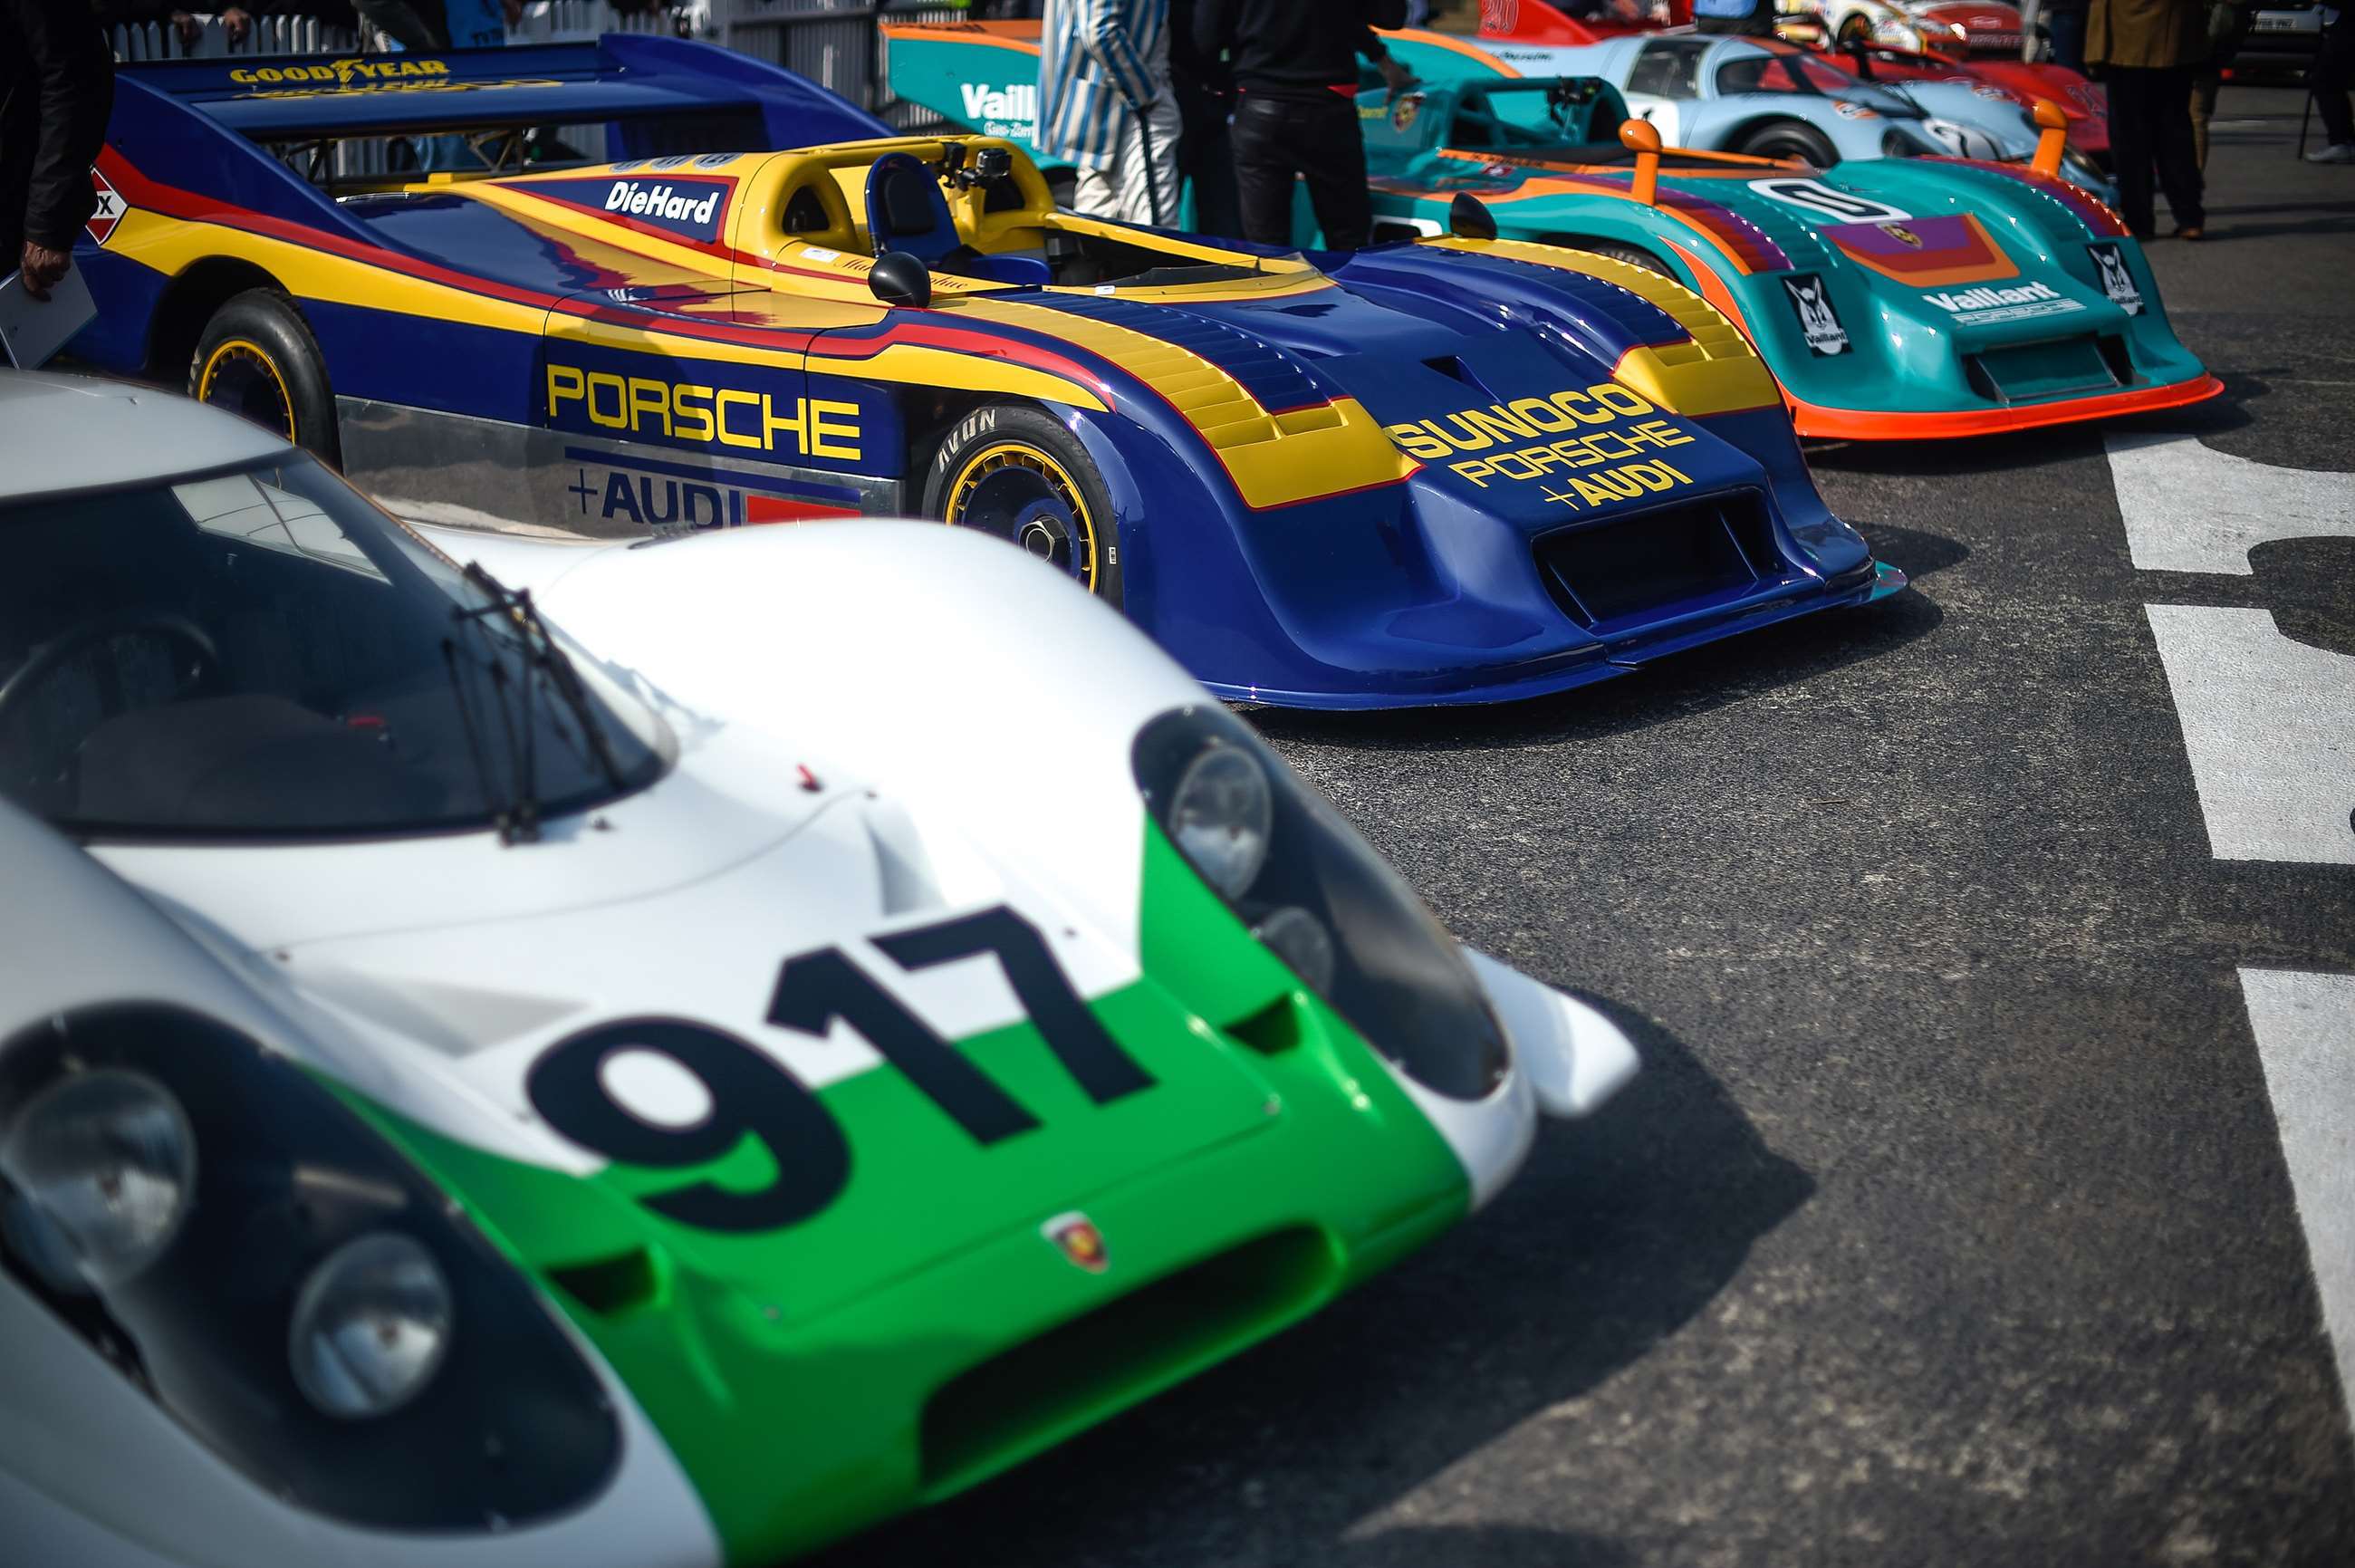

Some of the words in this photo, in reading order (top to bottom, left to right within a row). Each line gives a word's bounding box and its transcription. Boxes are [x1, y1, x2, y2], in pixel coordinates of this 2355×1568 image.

[960, 82, 1036, 120] Vaill
[604, 181, 720, 225] DieHard
[1921, 281, 2062, 313] Vaillant
[1805, 328, 1847, 344] Vaillant
[546, 363, 861, 461] PORSCHE
[938, 409, 995, 474] AVON
[1382, 383, 1654, 458] SUNOCO
[1448, 420, 1696, 488] PORSCHE
[523, 902, 1161, 1236] 917
